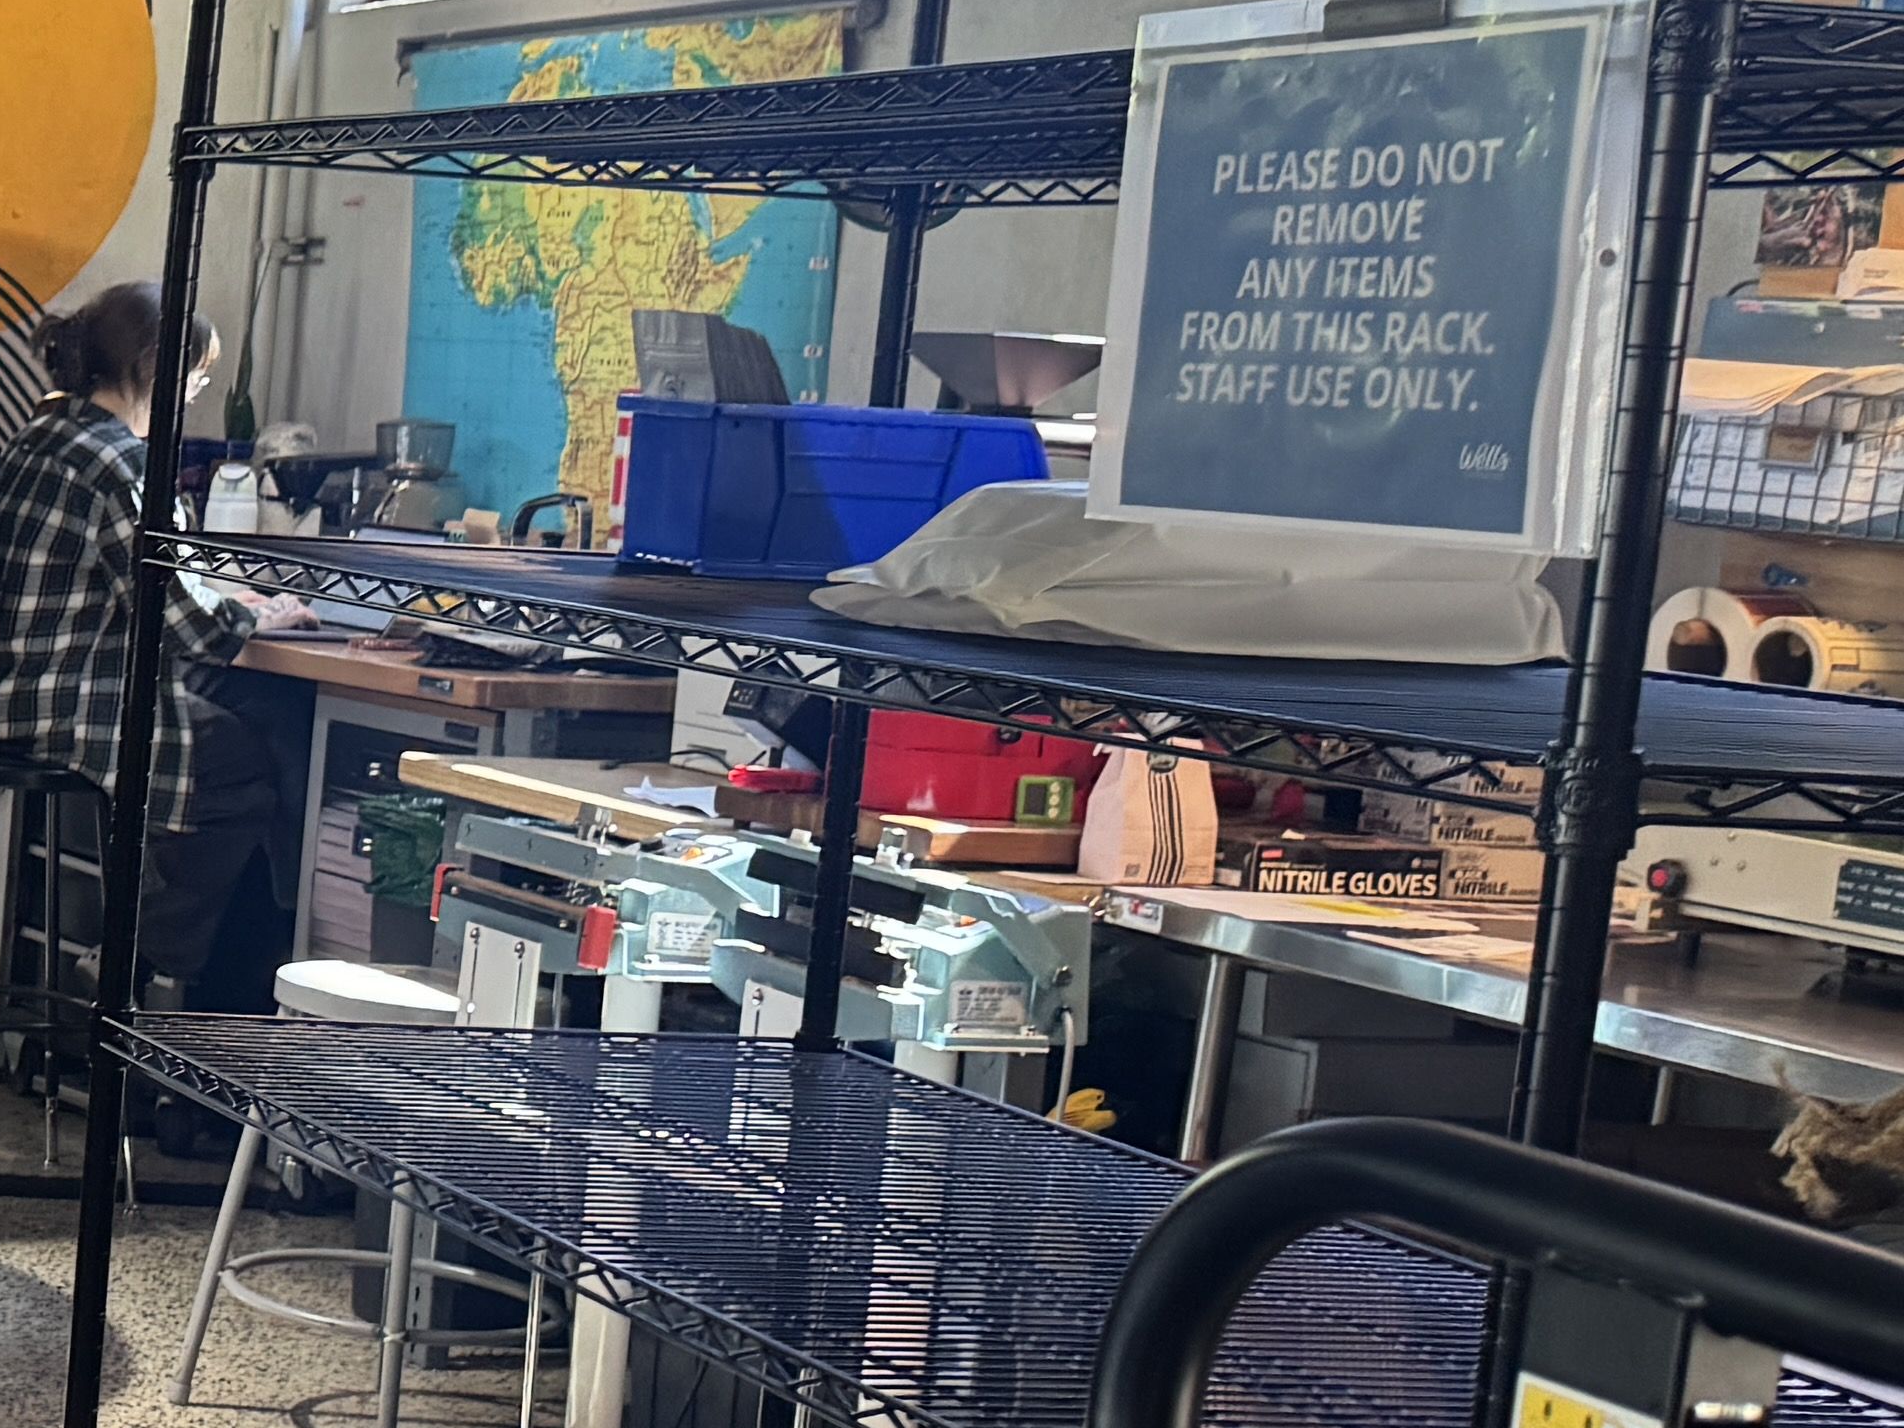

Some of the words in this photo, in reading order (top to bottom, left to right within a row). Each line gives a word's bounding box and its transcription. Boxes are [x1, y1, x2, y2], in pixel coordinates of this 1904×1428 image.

[1212, 147, 1342, 195] PLEASE
[1348, 143, 1405, 189] DO
[1416, 137, 1505, 186] NOT
[1270, 197, 1427, 246] REMOVE
[1235, 256, 1317, 299] ANY
[1323, 255, 1438, 299] ITEMS
[1178, 310, 1282, 352] FROM
[1292, 310, 1375, 354] THIS
[1381, 310, 1496, 355] RACK.
[1174, 362, 1279, 405] STAFF
[1286, 365, 1354, 408] USE
[1362, 366, 1479, 413] ONLY.
[1437, 825, 1495, 843] NITRILE
[1258, 868, 1347, 895] NITRILE
[1348, 872, 1438, 898] GLOVES
[1453, 878, 1508, 897] NITRILE
